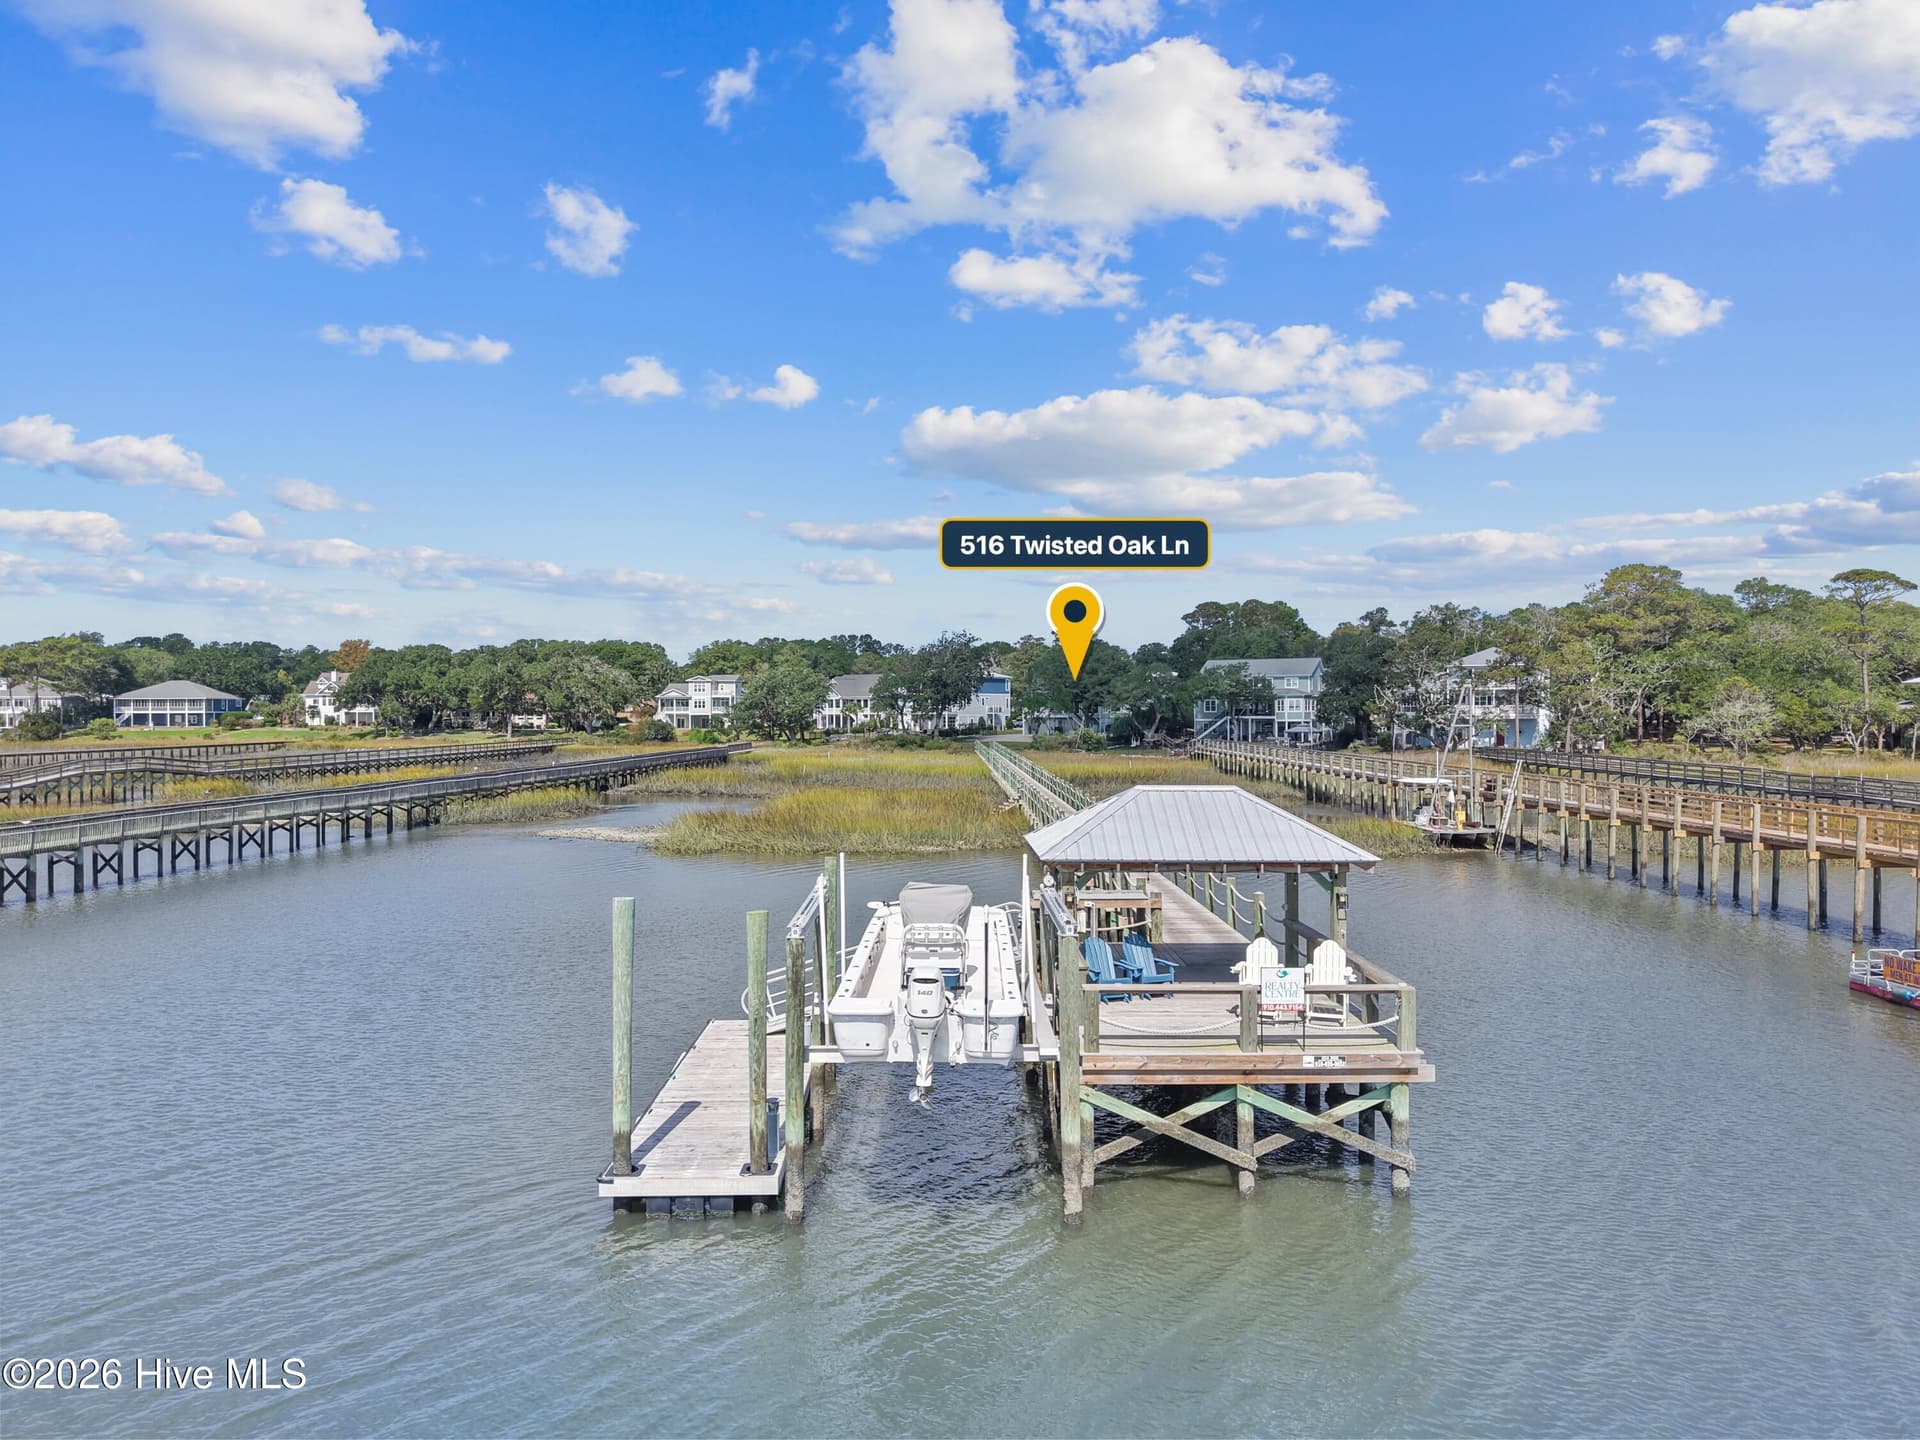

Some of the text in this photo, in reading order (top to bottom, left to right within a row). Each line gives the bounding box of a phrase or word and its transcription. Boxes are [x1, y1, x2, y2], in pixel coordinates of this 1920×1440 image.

[1884, 955, 1916, 973] NO WAKE
[1890, 969, 1903, 981] MEN
[1903, 972, 1912, 984] AT
[1264, 981, 1300, 991] REALTY
[1264, 989, 1301, 998] CENTRE
